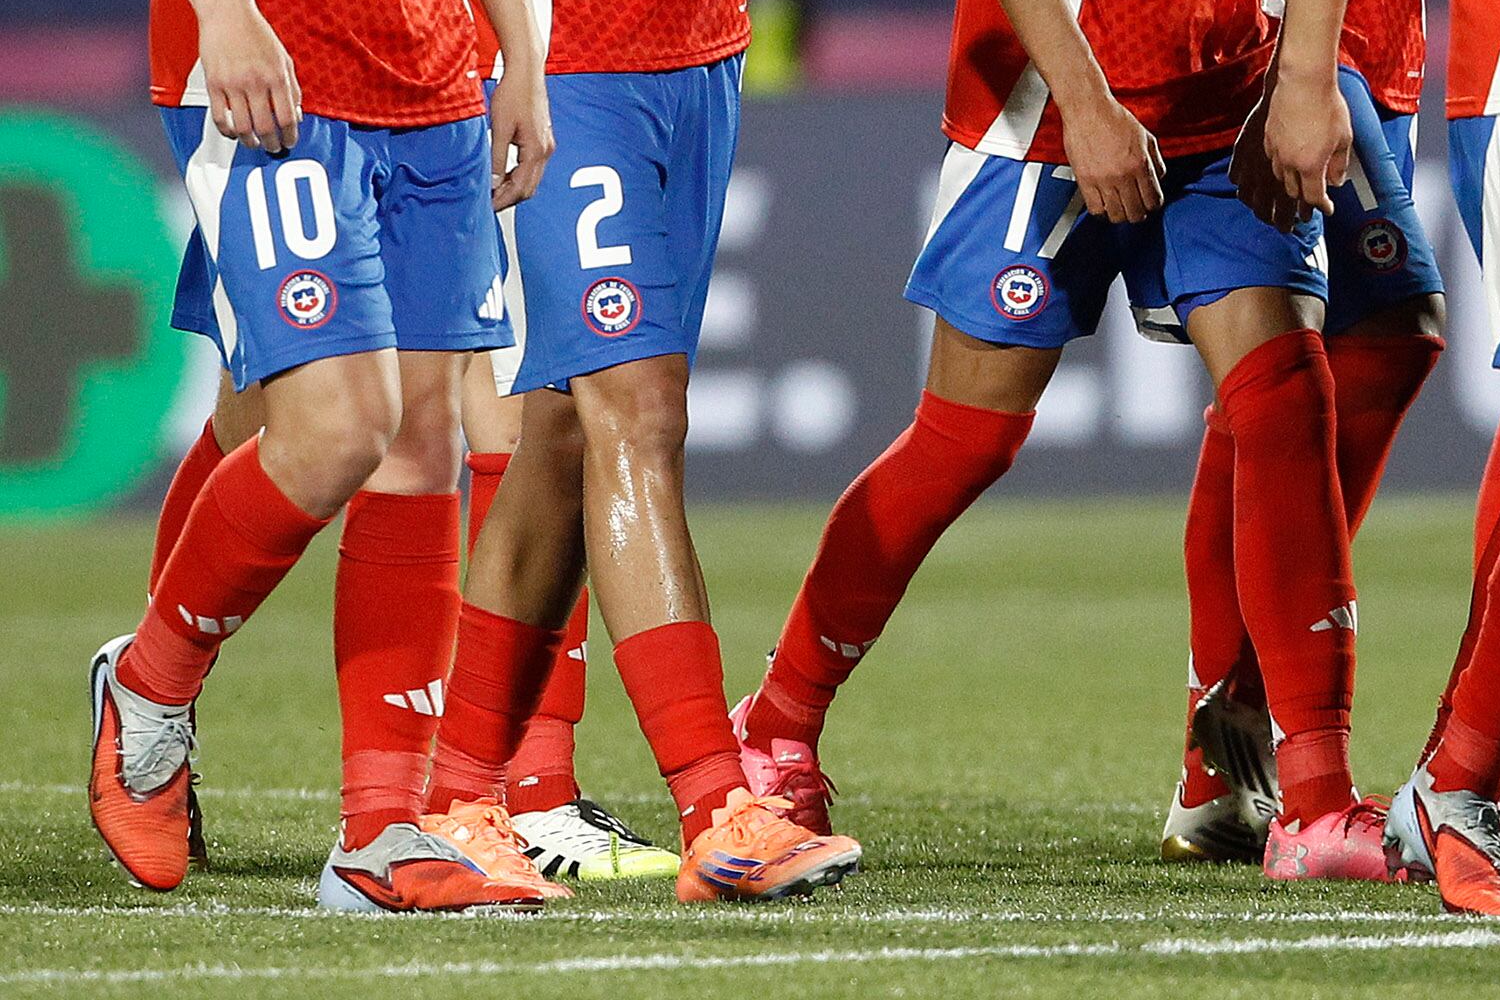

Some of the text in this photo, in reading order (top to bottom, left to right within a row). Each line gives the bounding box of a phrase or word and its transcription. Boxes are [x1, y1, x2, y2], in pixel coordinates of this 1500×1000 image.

[246, 158, 337, 270] 10
[569, 166, 632, 270] 2
[1003, 162, 1086, 260] 17
